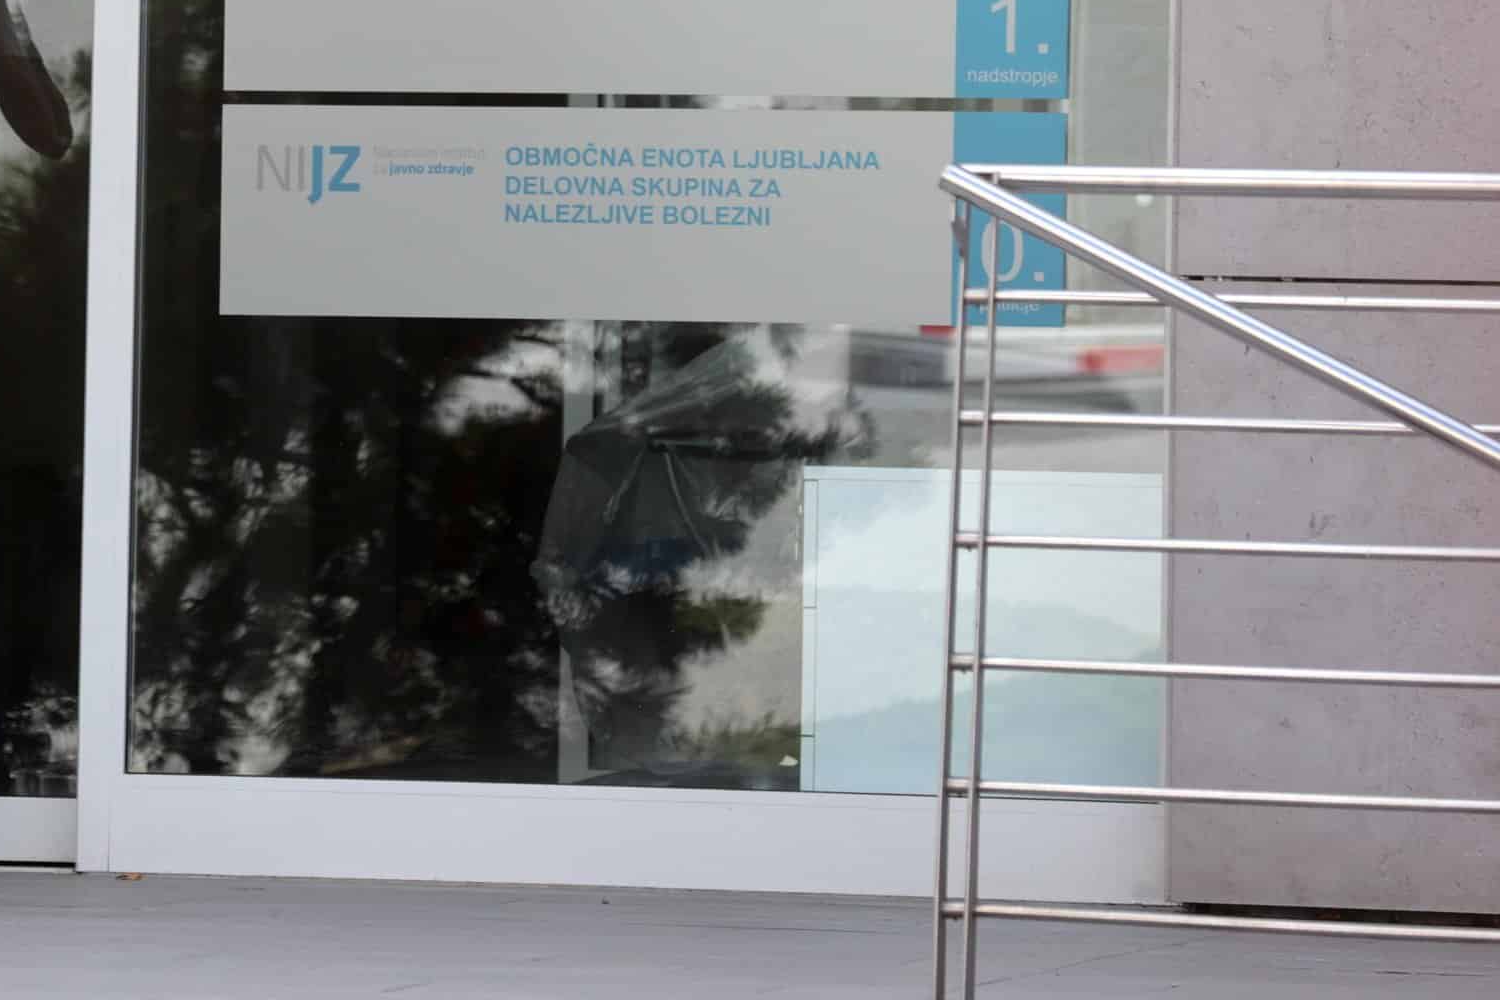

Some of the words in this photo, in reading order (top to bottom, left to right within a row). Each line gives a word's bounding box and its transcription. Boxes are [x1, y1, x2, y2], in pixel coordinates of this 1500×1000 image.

[967, 67, 1060, 87] nadstropje
[505, 143, 634, 168] OBMOČNA
[642, 148, 725, 169] ENOTA
[732, 149, 881, 171] LJUBLJANA
[257, 144, 362, 206] NIJZ
[505, 176, 624, 197] DELOVNA
[631, 177, 741, 198] SKUPINA
[748, 178, 781, 199] ZA
[505, 204, 653, 225] NALEZLJIVE
[662, 206, 770, 227] BOLEZNI
